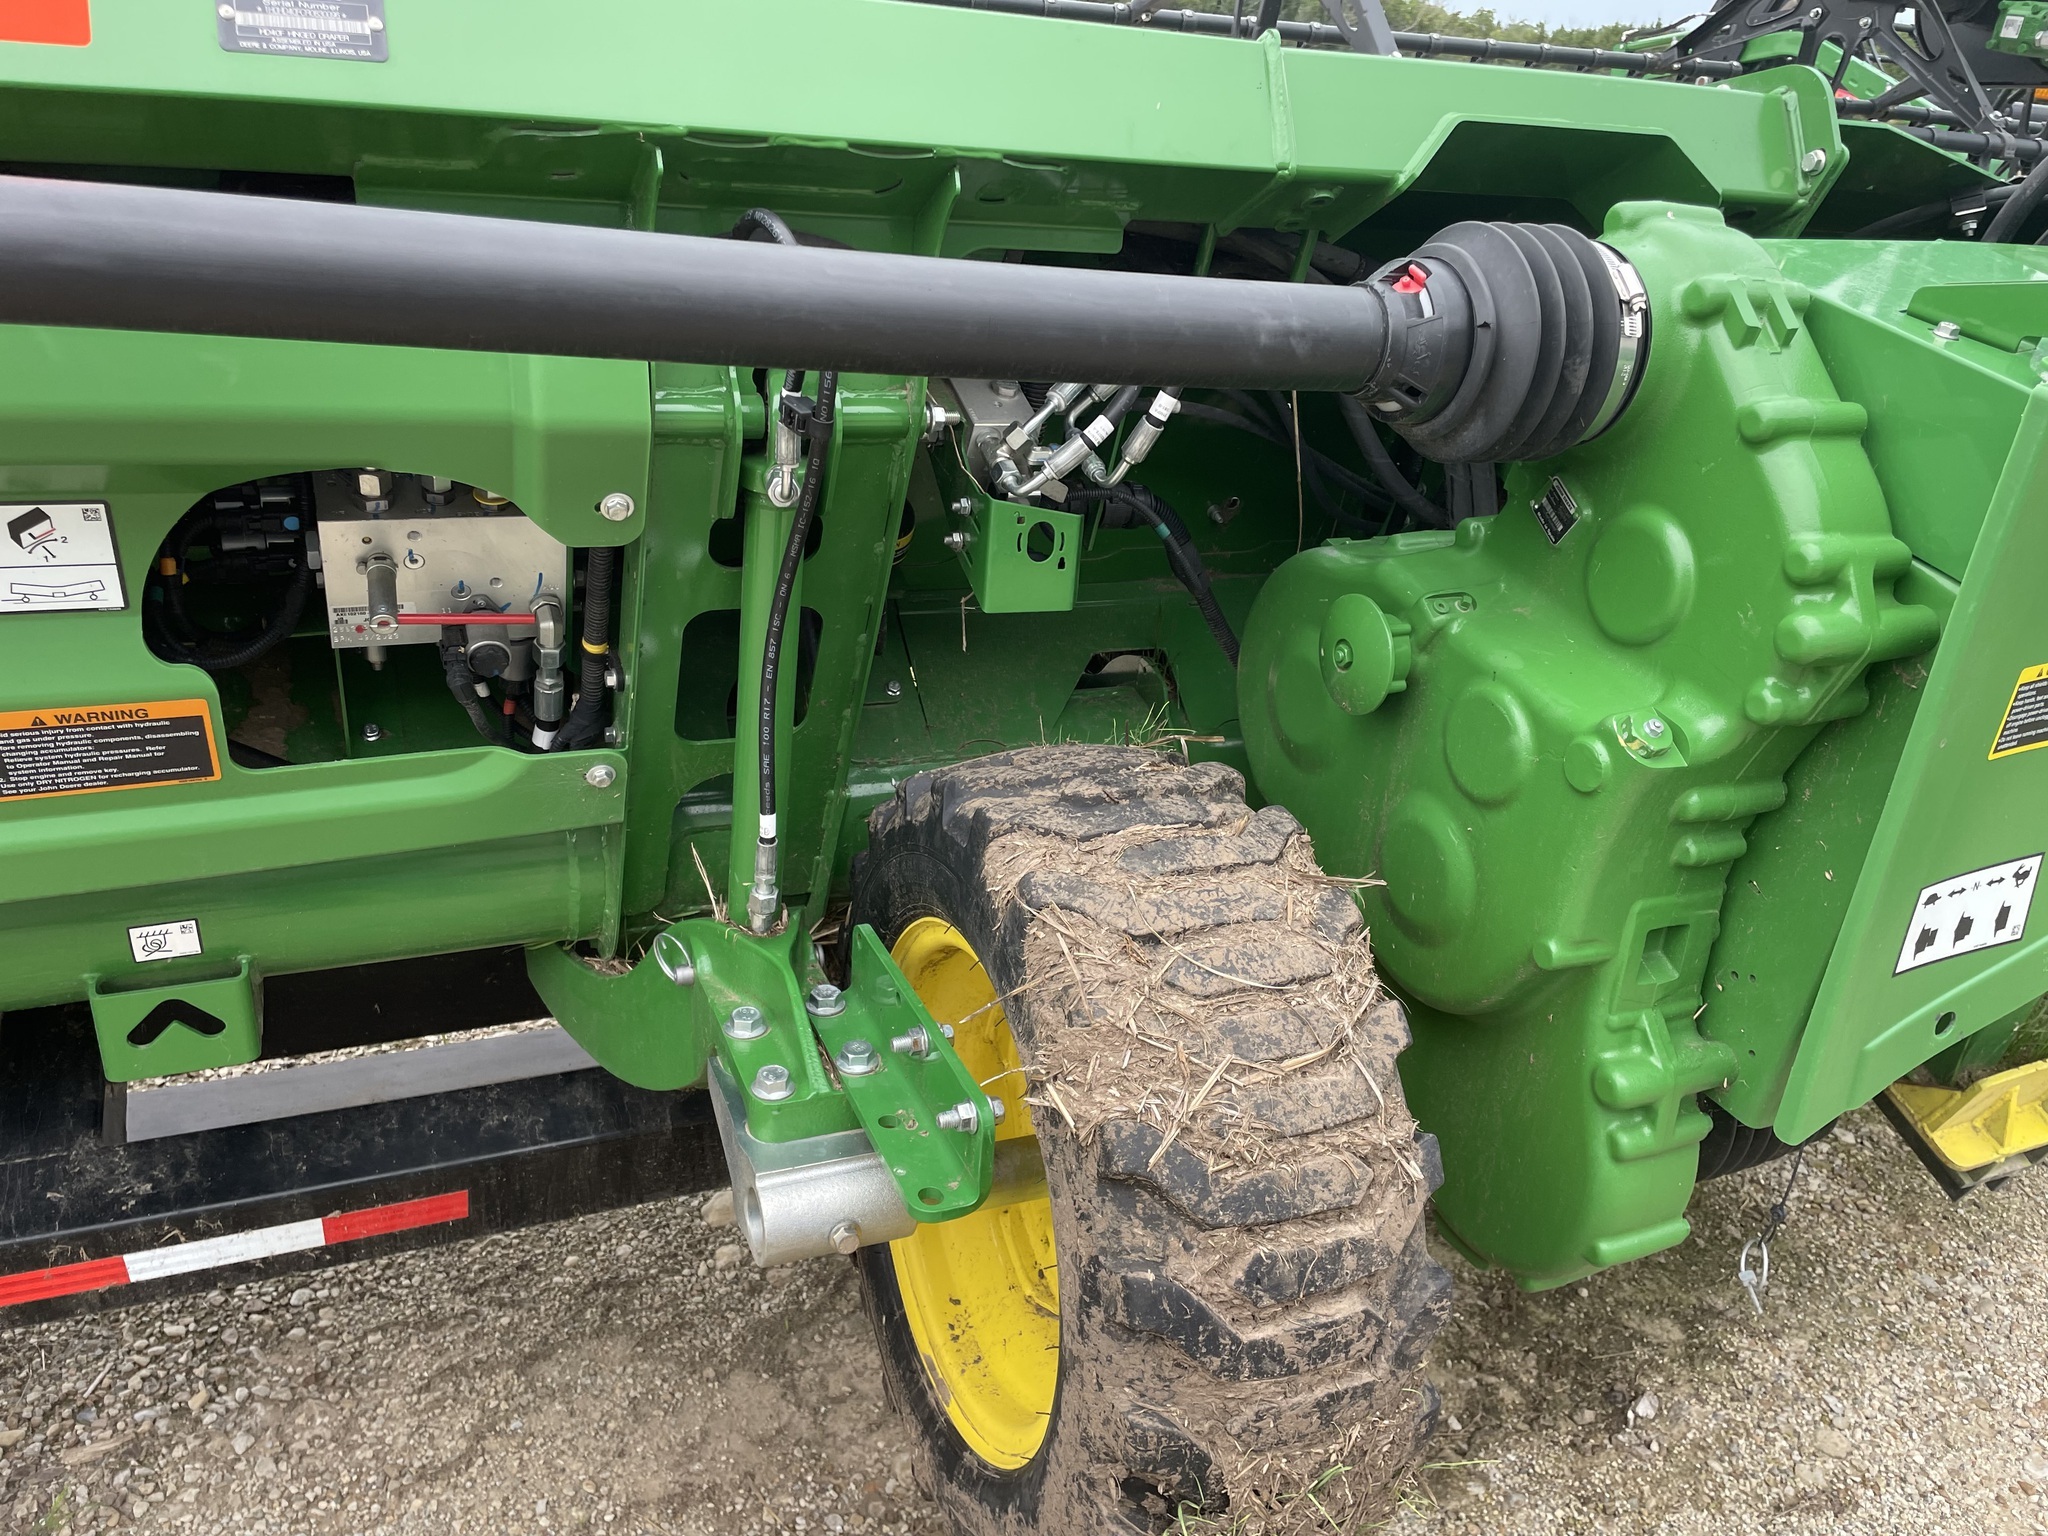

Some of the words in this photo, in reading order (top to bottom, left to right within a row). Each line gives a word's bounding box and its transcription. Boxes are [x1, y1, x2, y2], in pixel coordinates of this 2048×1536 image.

[298, 1, 340, 11] Number
[318, 33, 350, 42] DRAPER
[798, 477, 816, 529] IC-152/16
[790, 534, 802, 557] MSHA
[780, 583, 788, 597] DN
[768, 638, 777, 659] 857
[766, 664, 774, 679] EN
[54, 708, 149, 724] WARNING
[93, 735, 143, 743] components,
[145, 730, 200, 739] disassembling
[40, 746, 95, 754] accumulators:
[16, 761, 51, 769] Operator
[38, 765, 85, 773] information.
[110, 770, 151, 778] recharging
[152, 766, 200, 774] accumulator.
